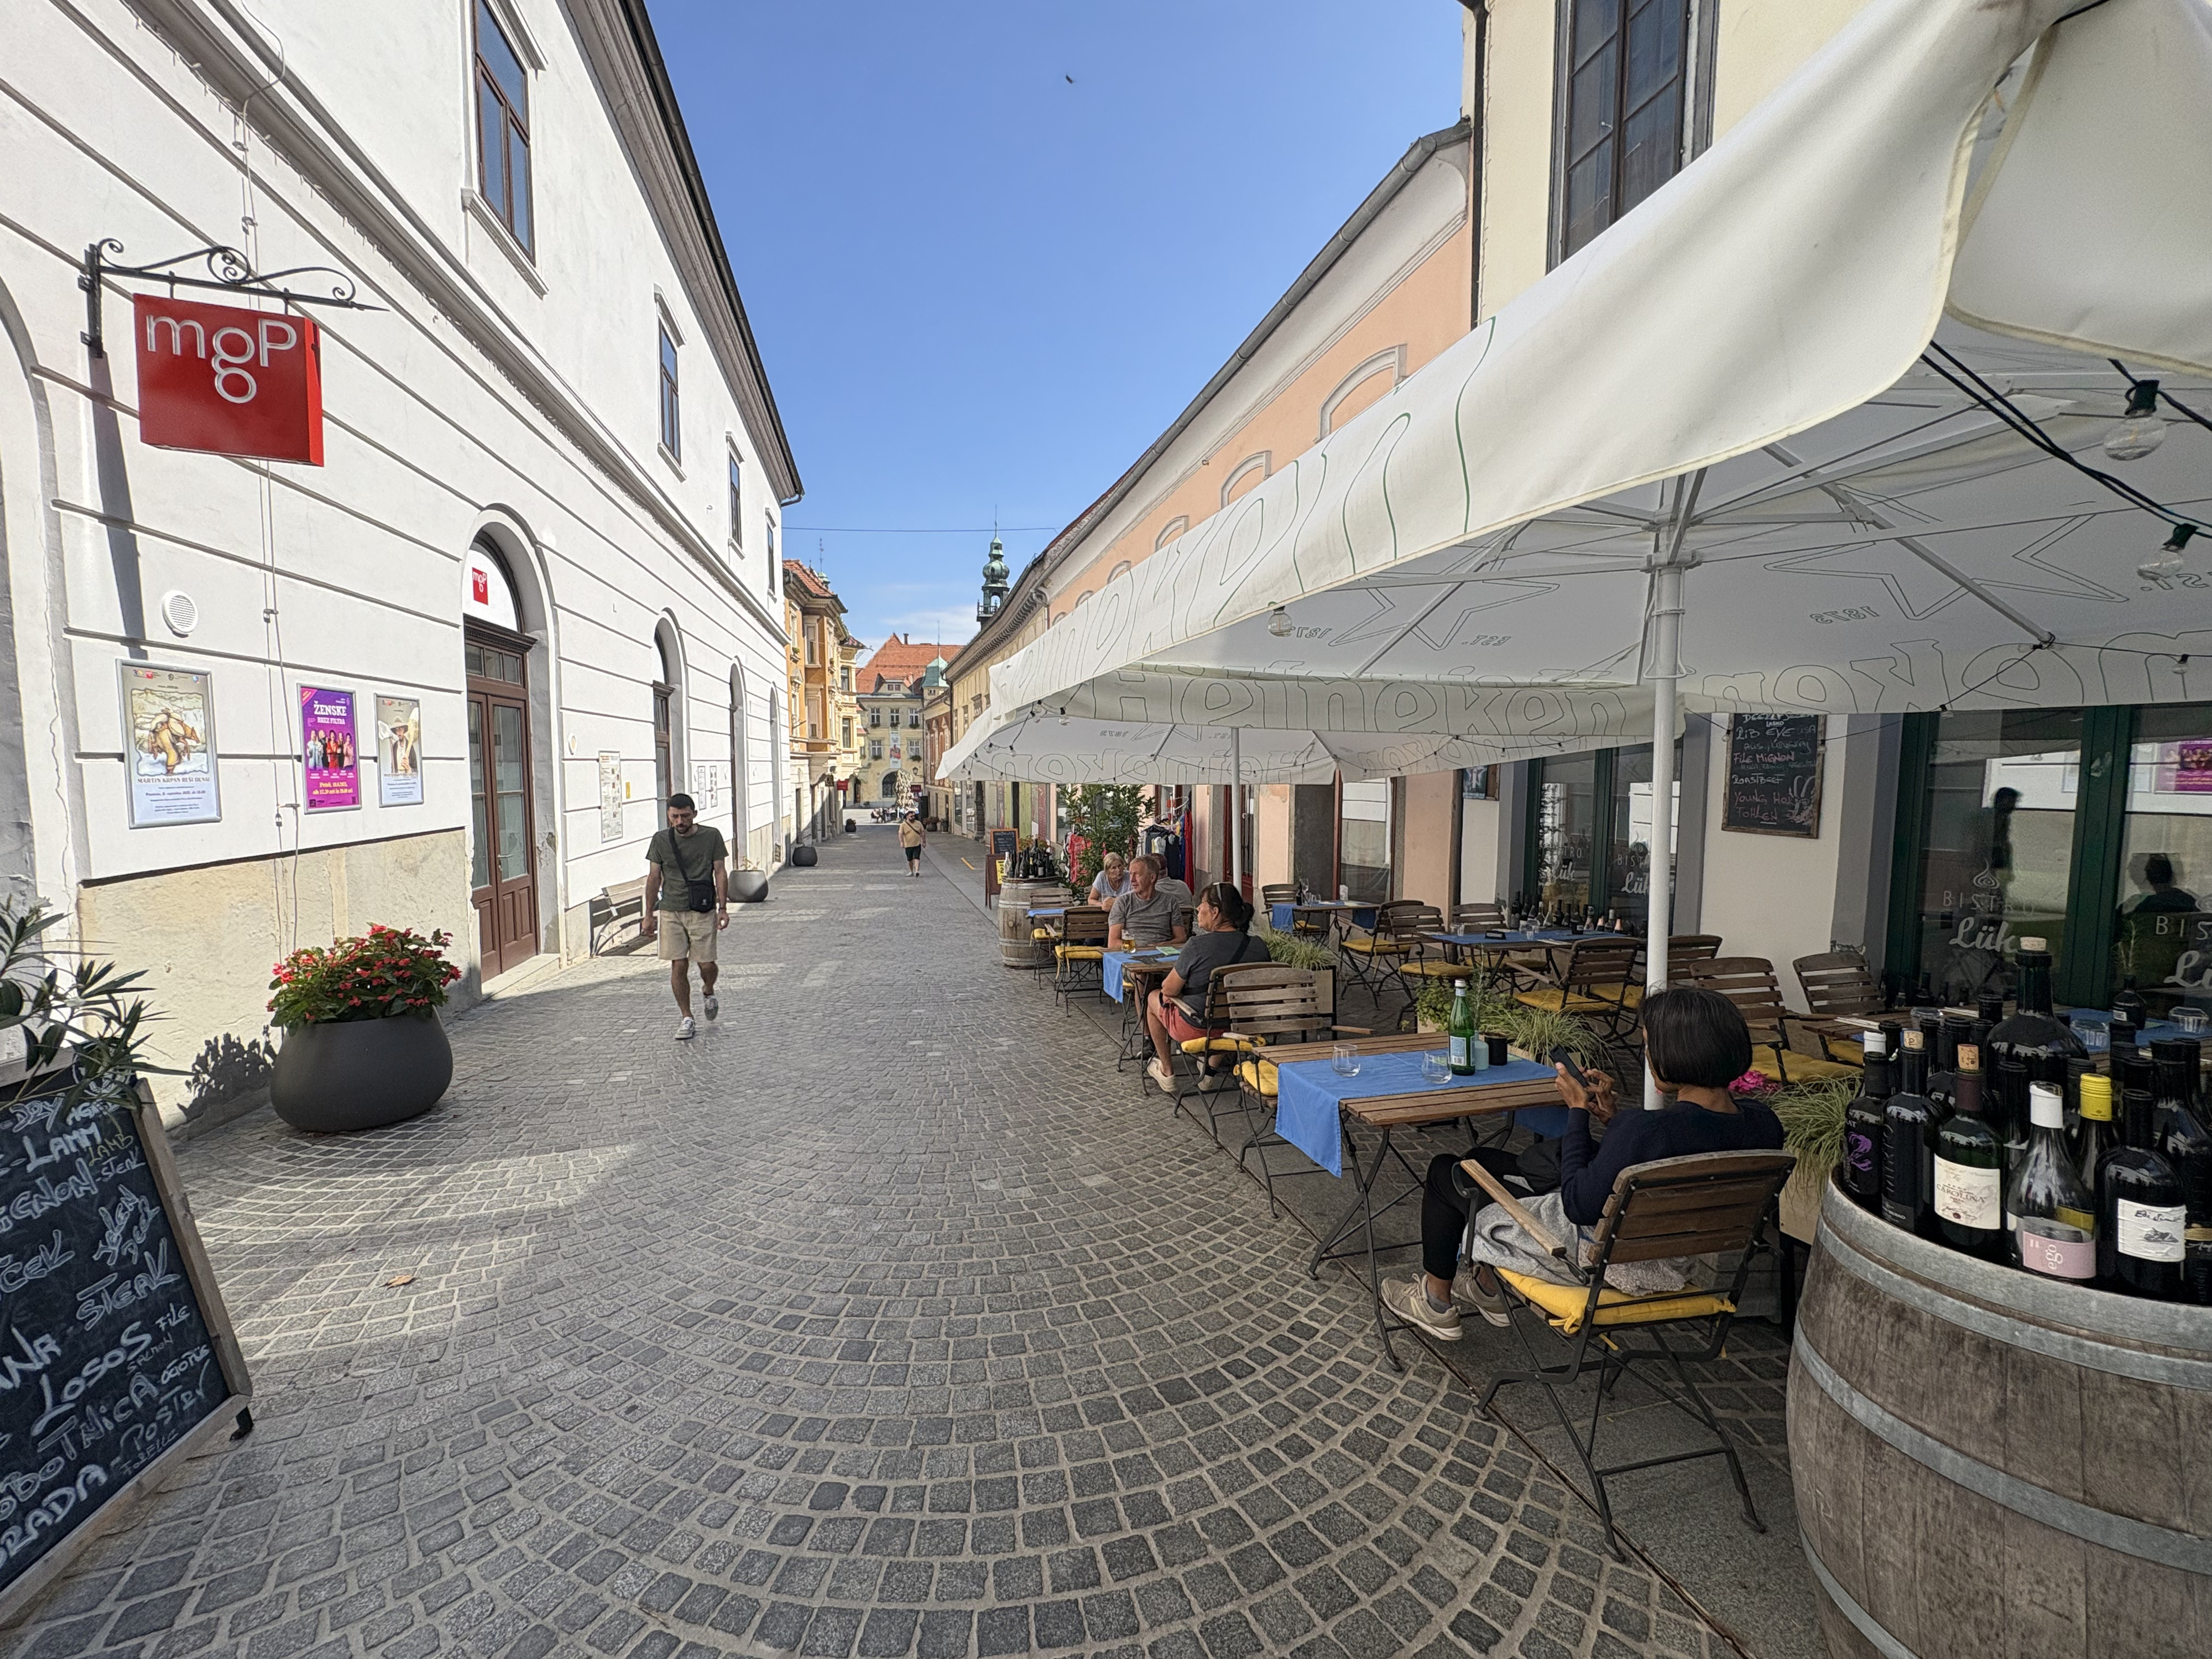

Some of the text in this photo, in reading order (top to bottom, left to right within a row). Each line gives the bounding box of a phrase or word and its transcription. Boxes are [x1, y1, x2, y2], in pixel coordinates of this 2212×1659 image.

[314, 700, 347, 717] ŽENSKE
[1948, 917, 2018, 953] Lük
[1936, 1183, 1985, 1204] CAROLINA
[76, 1237, 181, 1332] STEAK
[30, 1321, 153, 1437] LOSOS
